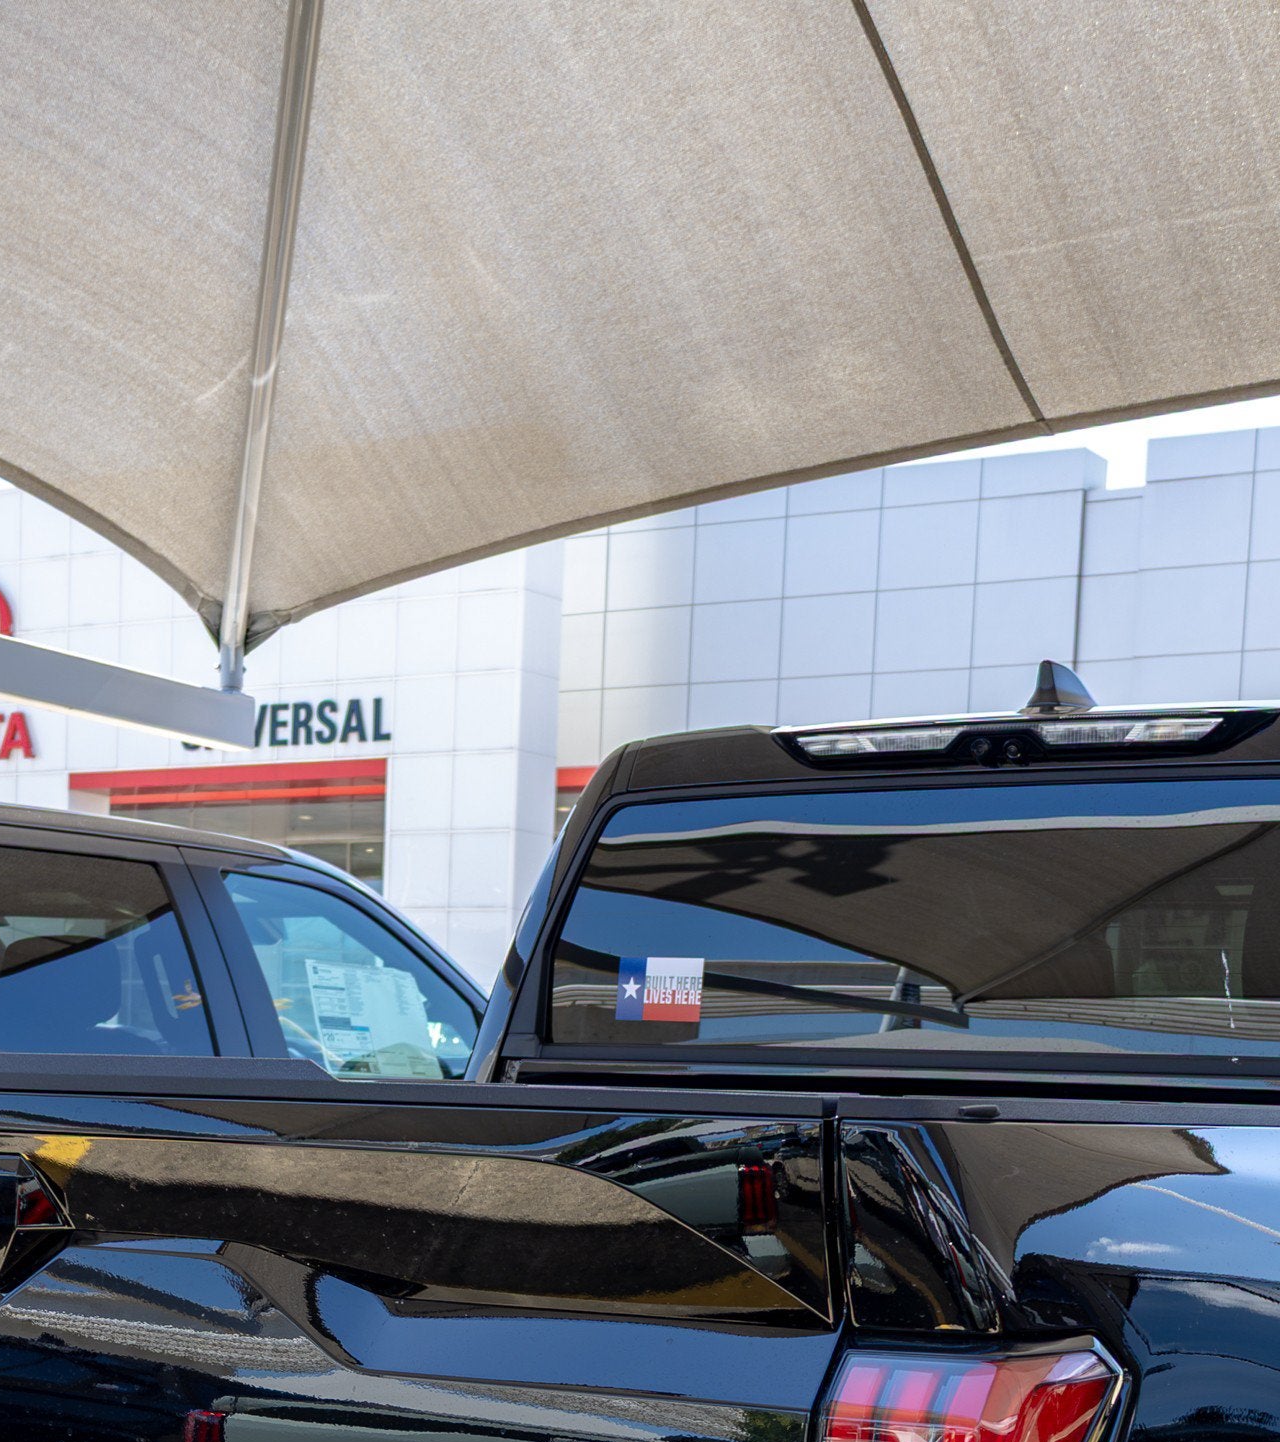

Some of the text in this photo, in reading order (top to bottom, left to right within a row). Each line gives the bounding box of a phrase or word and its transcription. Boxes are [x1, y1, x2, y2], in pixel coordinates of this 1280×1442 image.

[181, 697, 392, 751] VERSAL
[645, 975, 703, 991] BUILT HERE
[643, 989, 701, 1005] LIVES HERE
